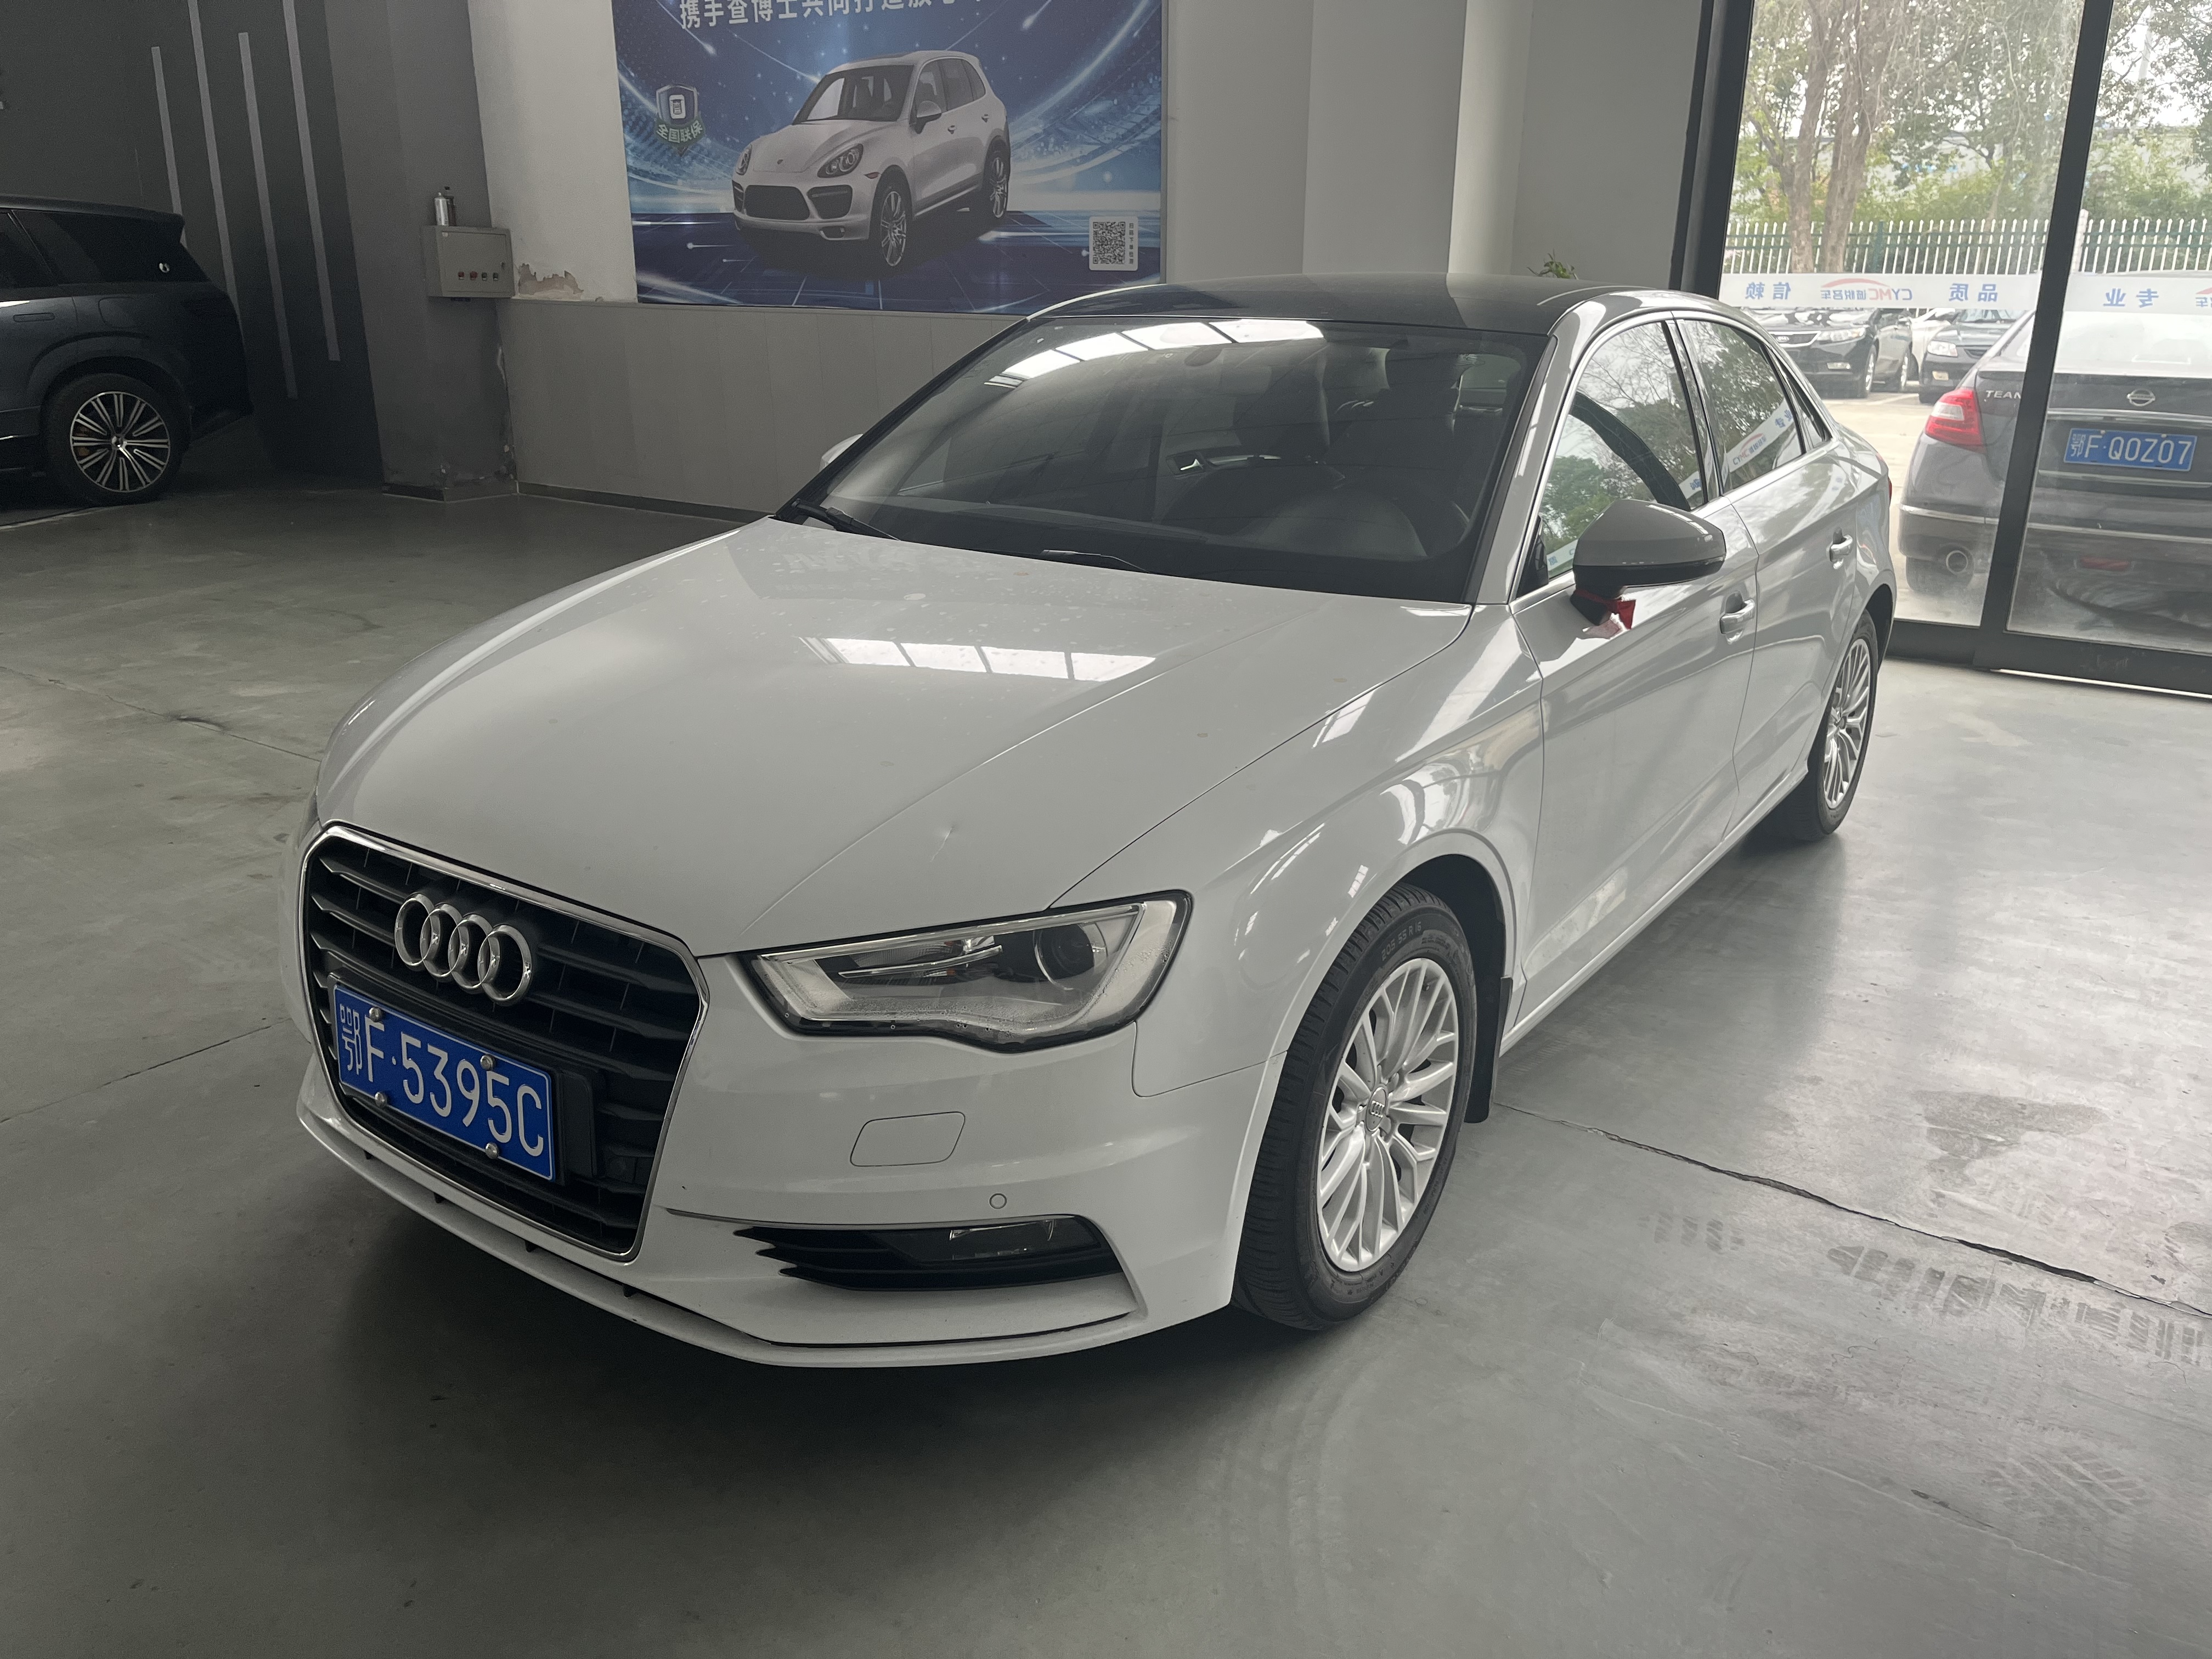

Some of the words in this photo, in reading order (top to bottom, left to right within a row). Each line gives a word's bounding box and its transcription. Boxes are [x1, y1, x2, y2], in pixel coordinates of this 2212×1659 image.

[657, 120, 703, 143] 全国联保
[1381, 938, 1396, 961] 205
[1398, 928, 1407, 944] 55
